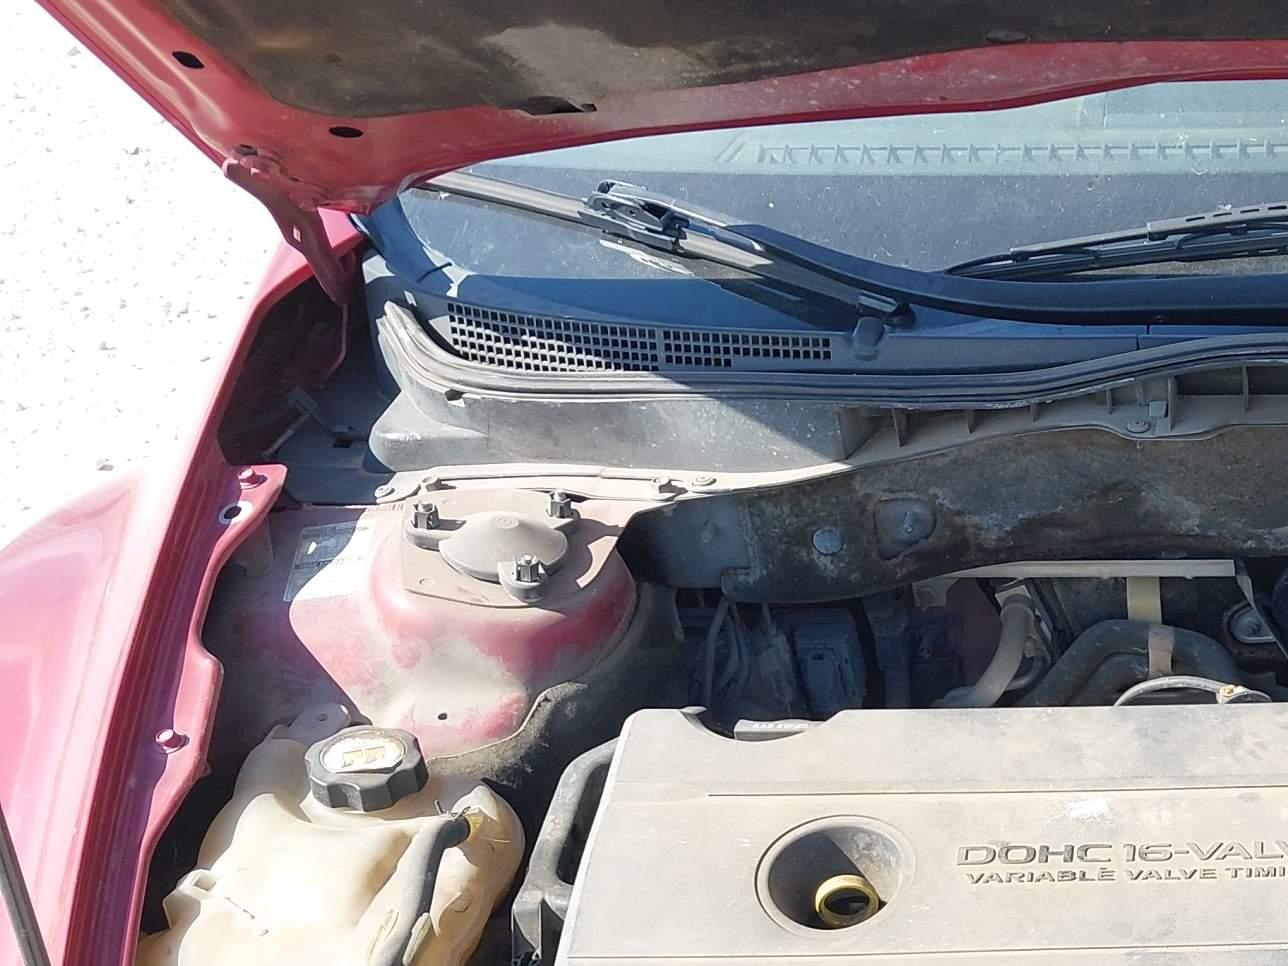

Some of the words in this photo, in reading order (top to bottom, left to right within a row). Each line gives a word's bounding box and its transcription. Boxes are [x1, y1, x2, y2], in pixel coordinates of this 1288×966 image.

[956, 843, 1112, 866] DOHC
[965, 866, 1116, 884] VARIABLE
[1125, 867, 1217, 881] VALVE
